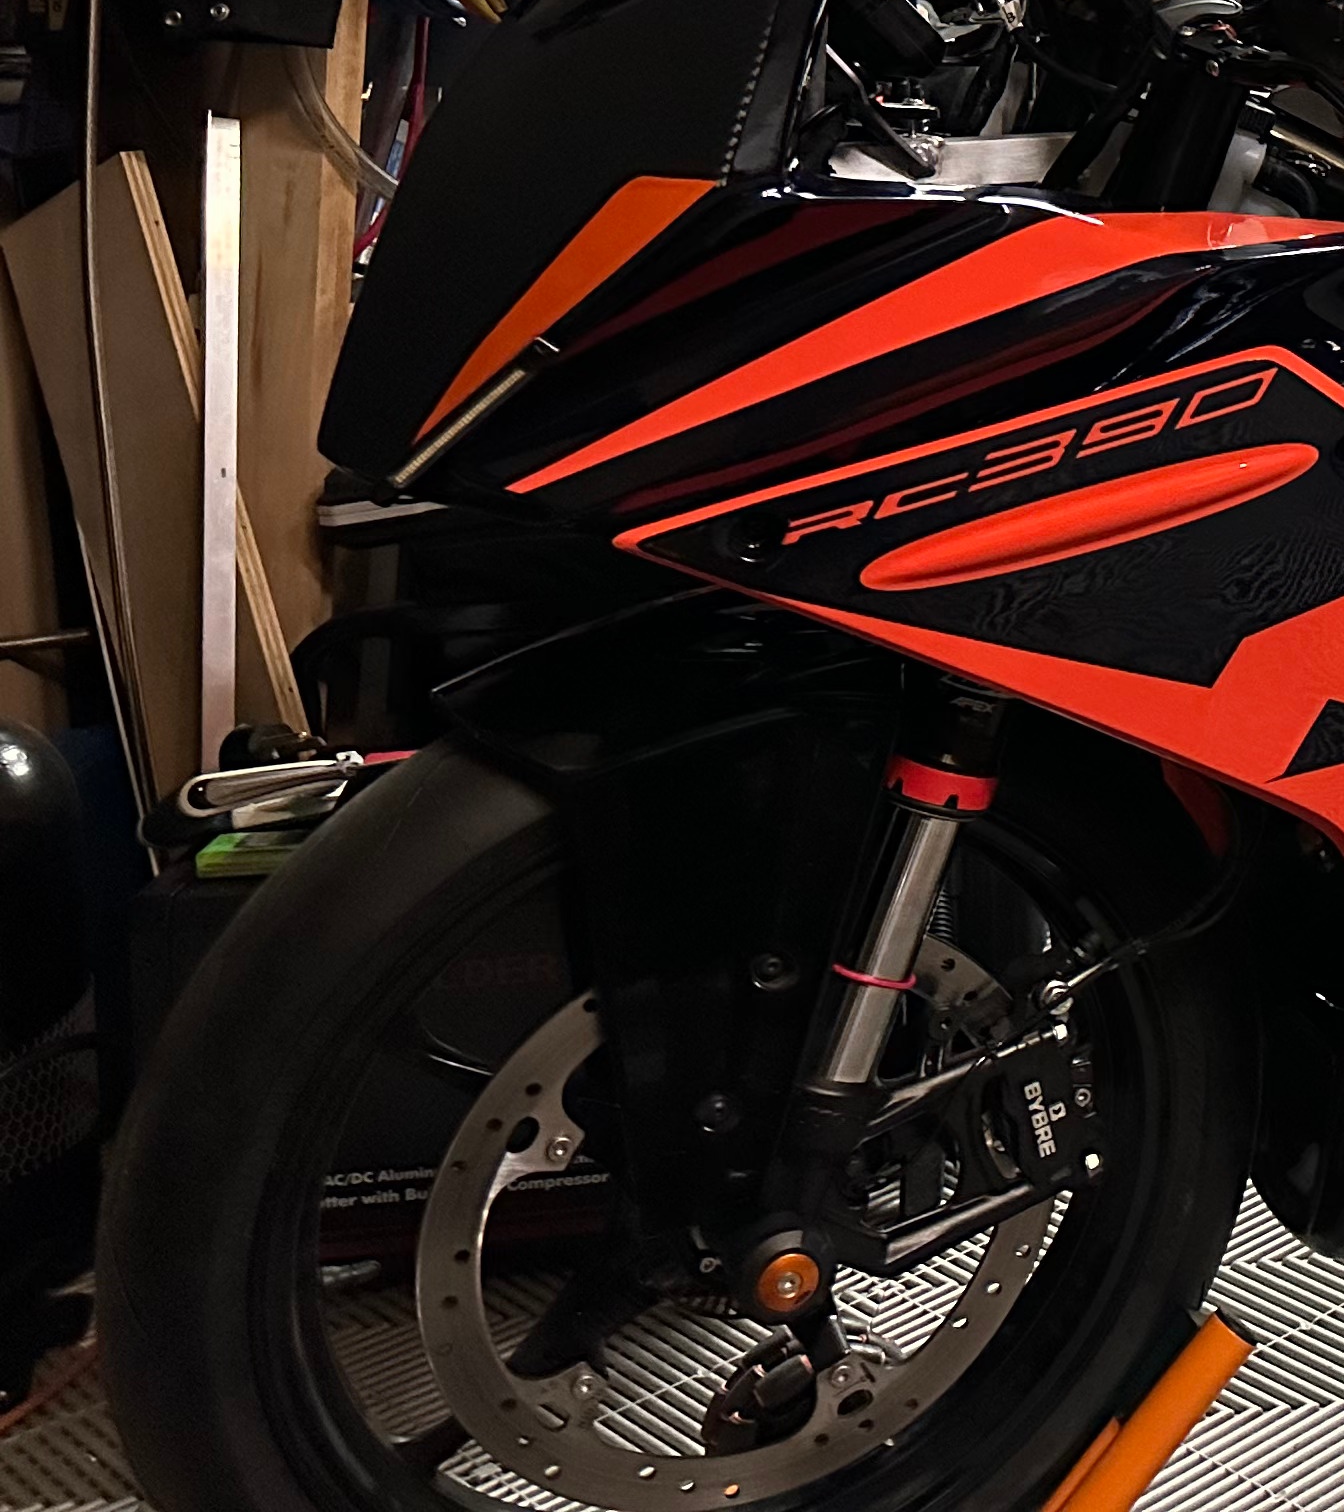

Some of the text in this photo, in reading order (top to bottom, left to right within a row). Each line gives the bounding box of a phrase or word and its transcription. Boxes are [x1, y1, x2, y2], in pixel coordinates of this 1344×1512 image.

[781, 367, 1279, 545] RC390
[1023, 1081, 1057, 1158] BYBRE
[361, 1191, 400, 1204] with
